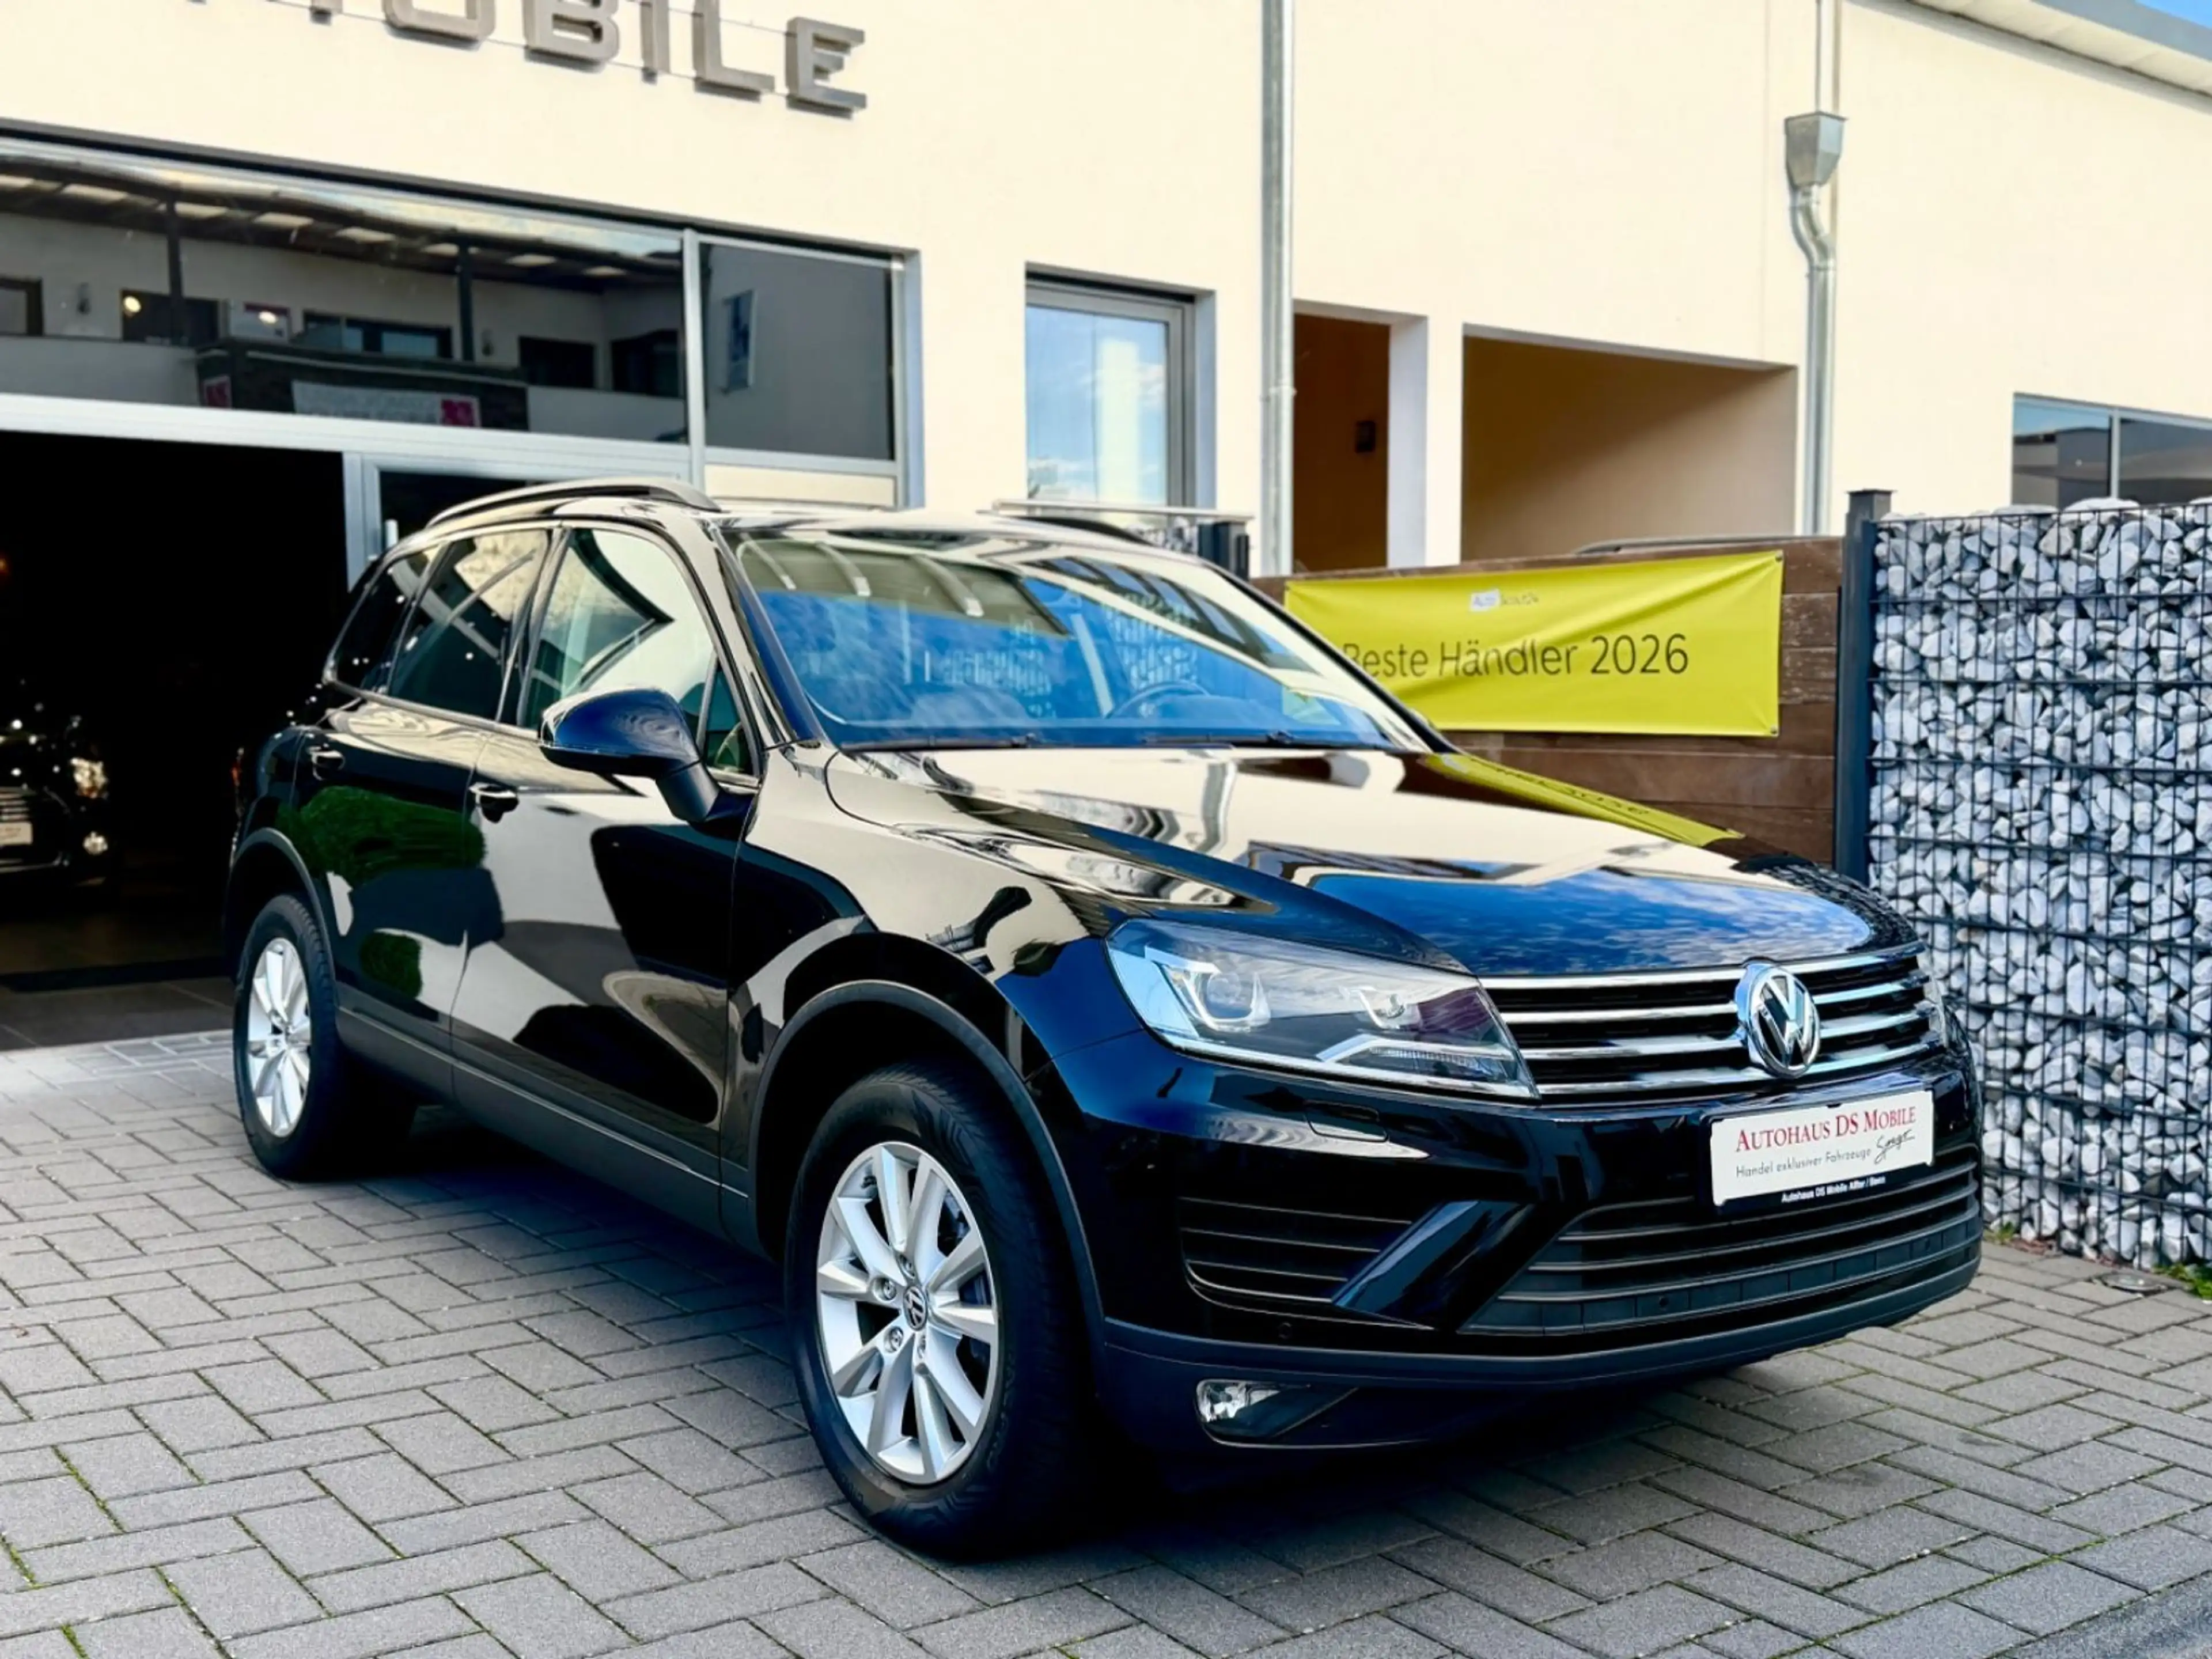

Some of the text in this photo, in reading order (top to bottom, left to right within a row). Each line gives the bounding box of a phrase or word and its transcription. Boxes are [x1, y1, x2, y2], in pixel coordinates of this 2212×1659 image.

[1438, 638, 1578, 677] Händler
[1590, 632, 1690, 676] 2026
[1736, 1105, 1916, 1152] AUTOHAUS DS MOBILE
[1736, 1148, 1872, 1178] Handel exklusiver Fahrzeuge
